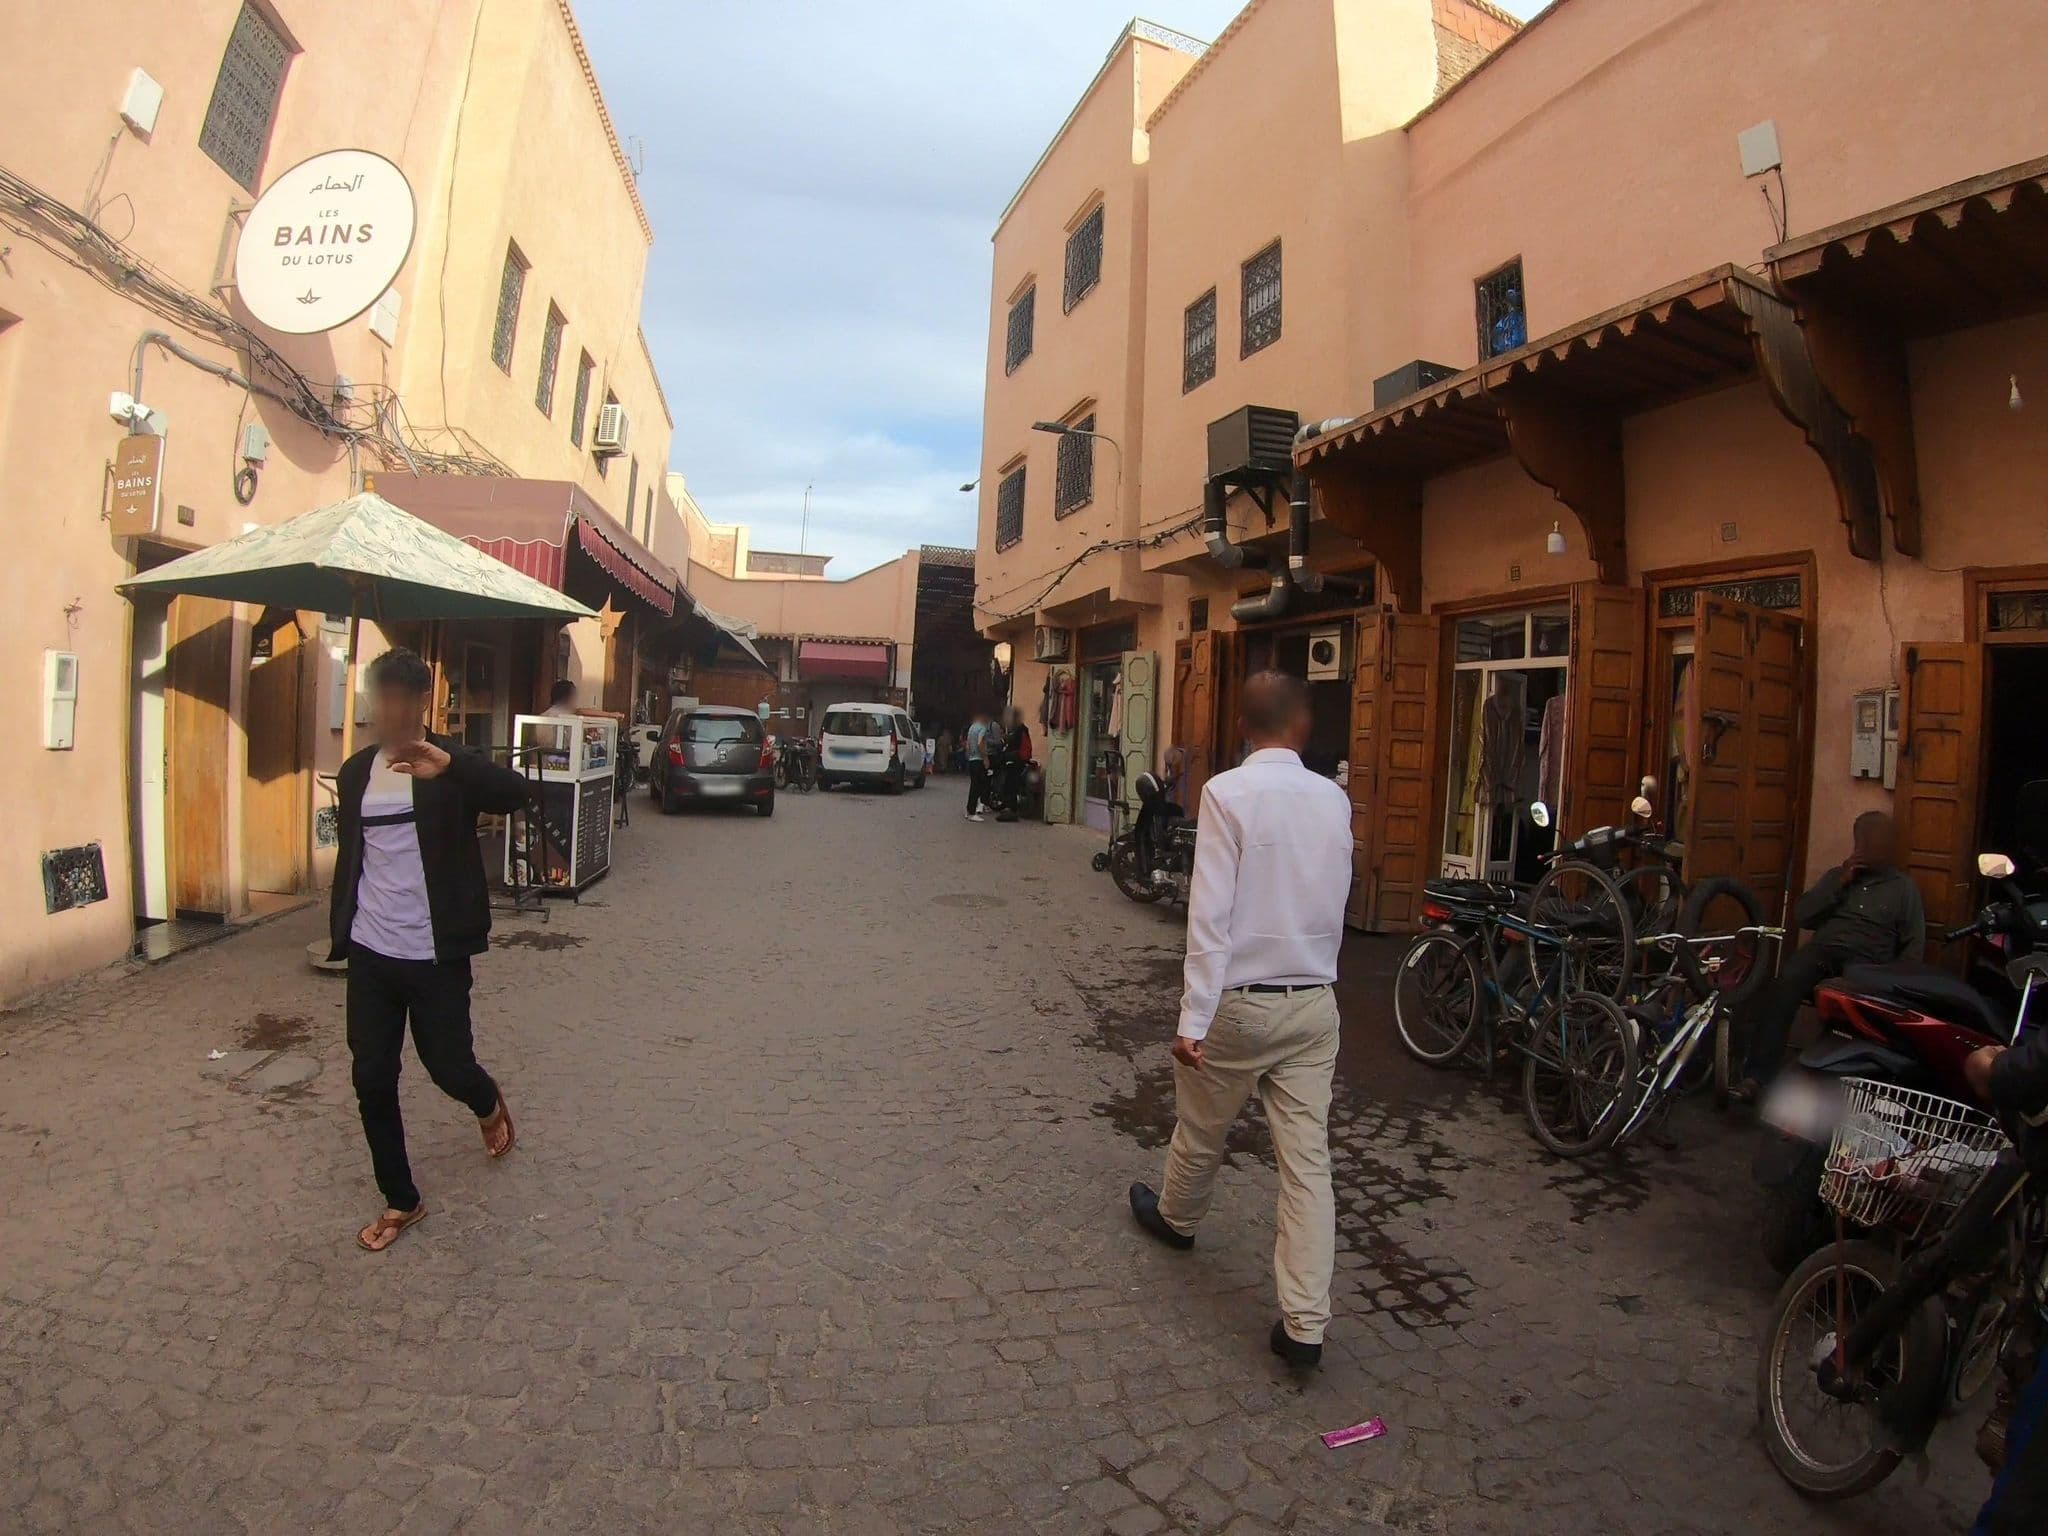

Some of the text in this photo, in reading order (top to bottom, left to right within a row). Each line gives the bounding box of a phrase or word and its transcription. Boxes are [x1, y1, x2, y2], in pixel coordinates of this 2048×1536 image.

[319, 209, 339, 218] LES
[274, 223, 374, 247] BAINS
[281, 254, 354, 266] DU LOTUS
[118, 477, 152, 489] BAINS
